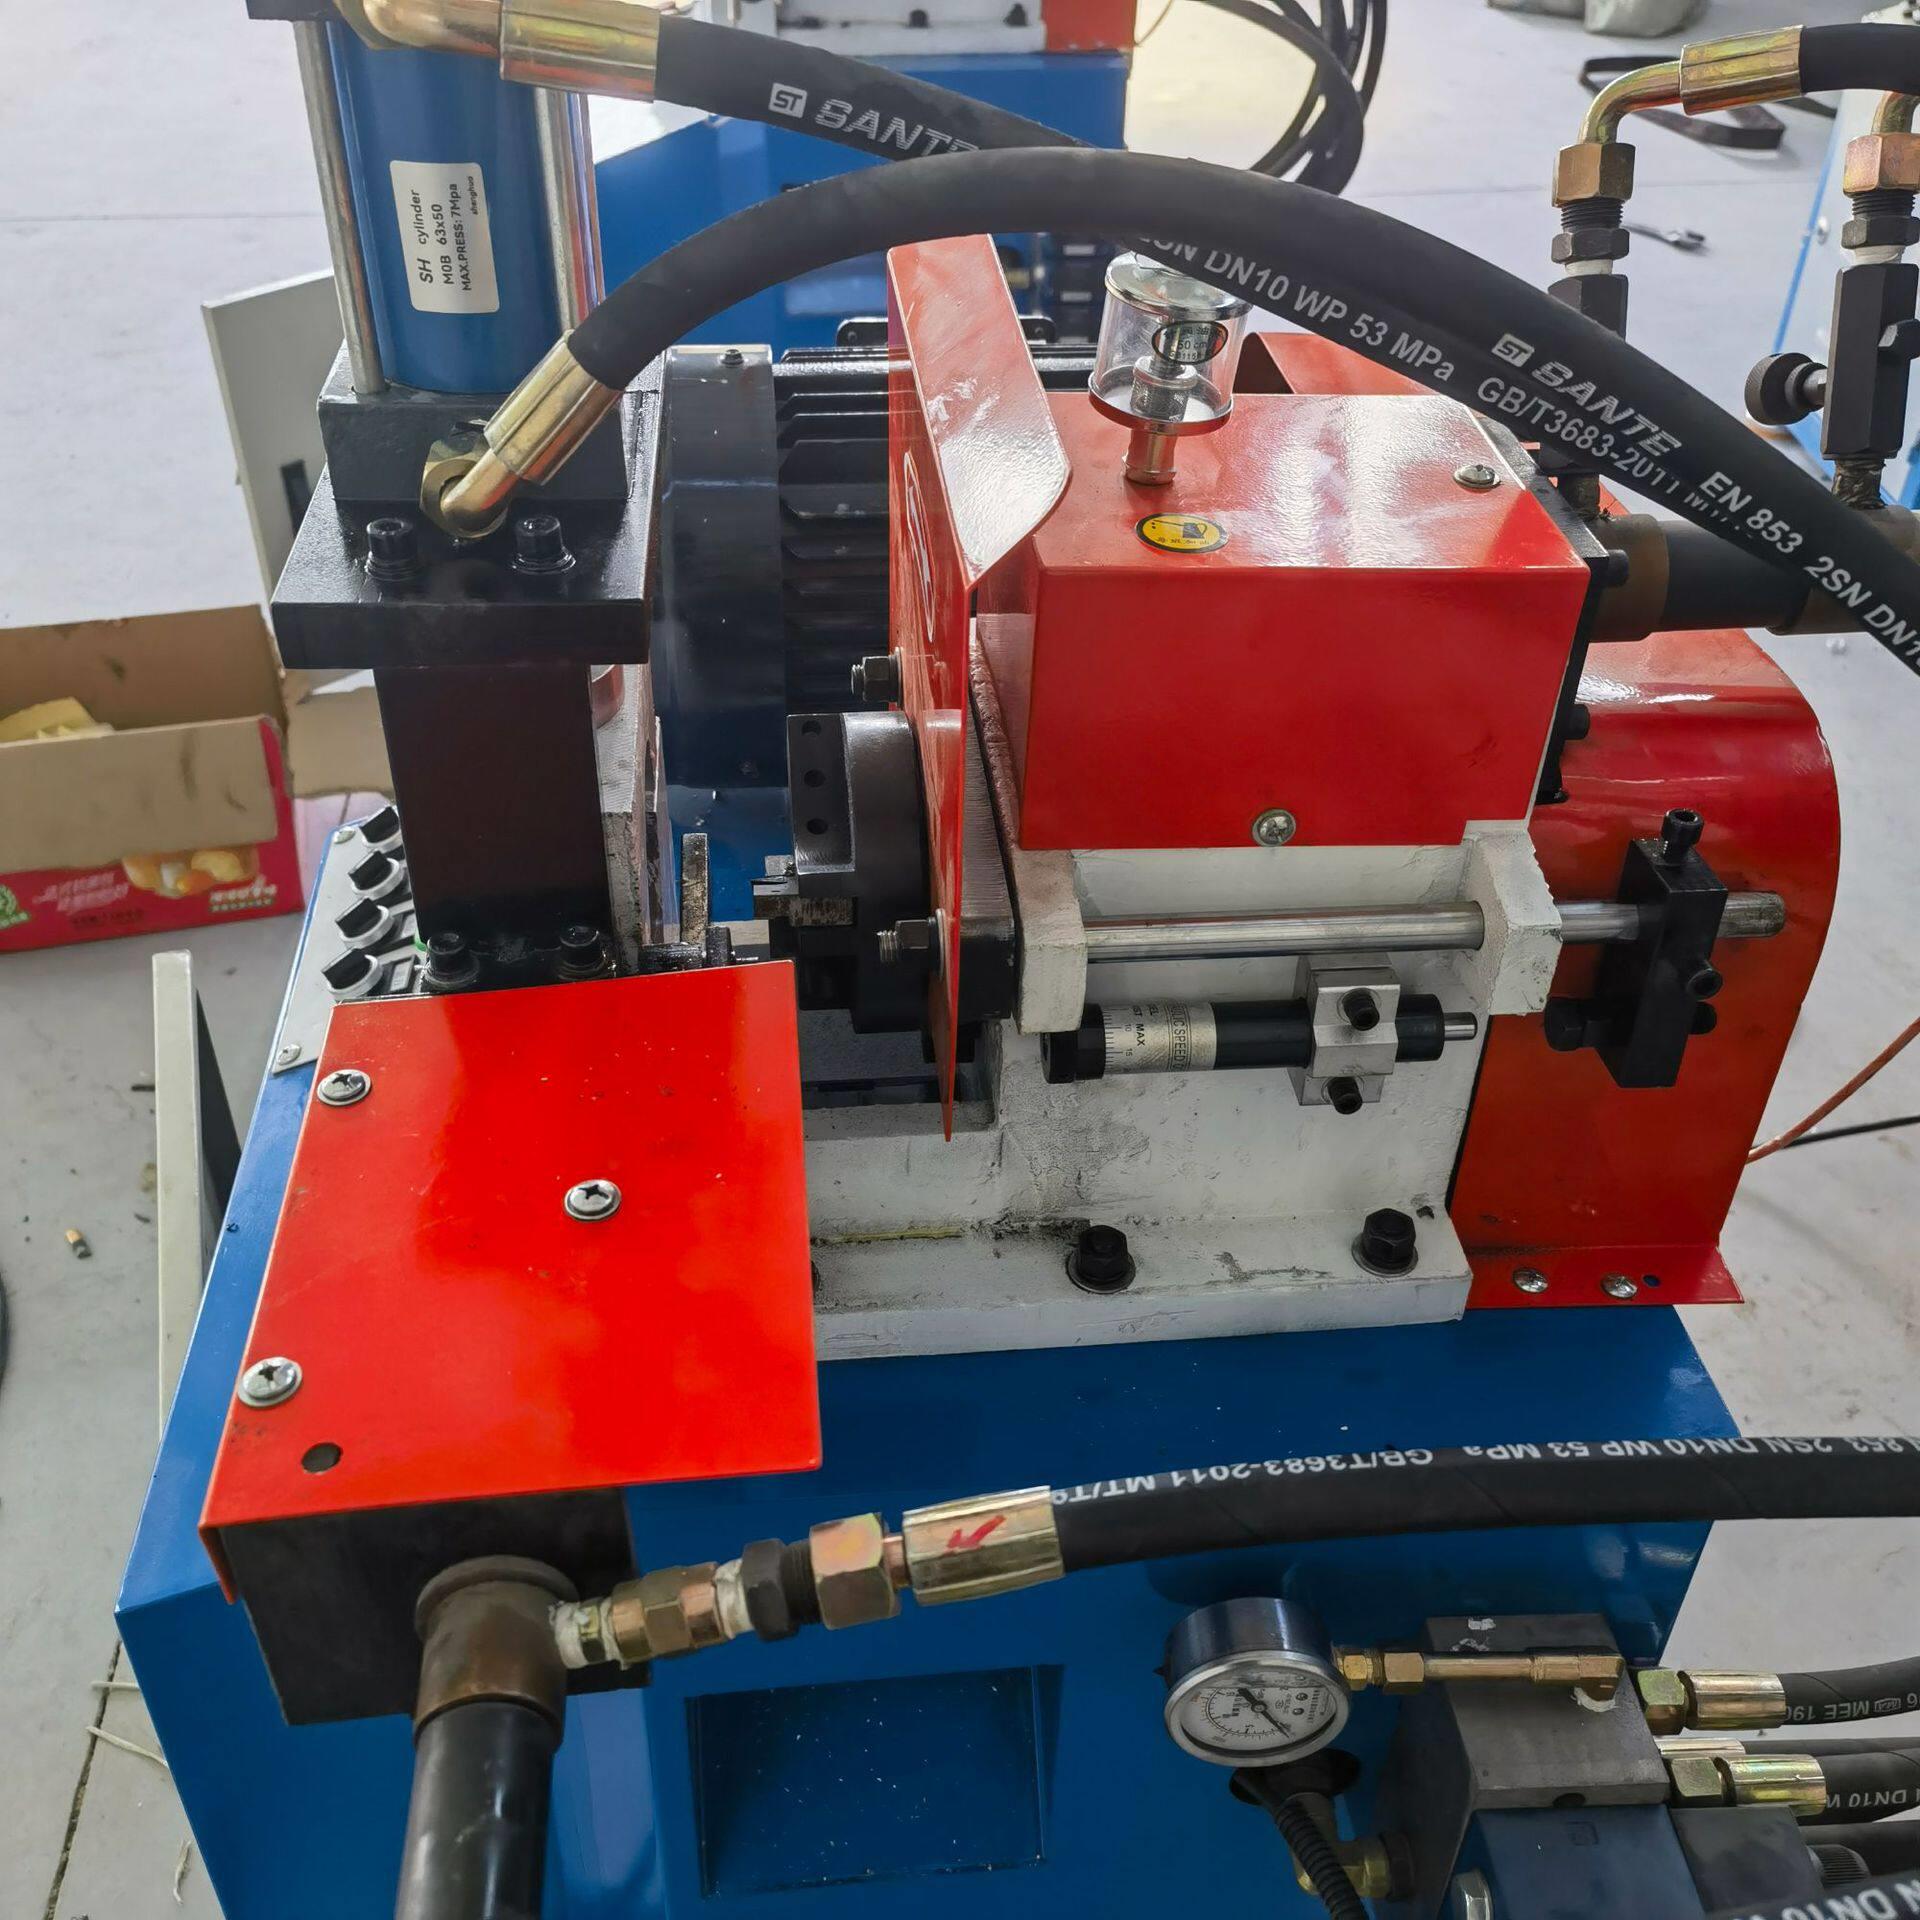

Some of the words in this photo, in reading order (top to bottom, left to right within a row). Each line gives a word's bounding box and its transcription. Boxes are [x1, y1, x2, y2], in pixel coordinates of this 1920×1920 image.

[410, 188, 430, 245] cylinder
[431, 203, 447, 245] 63x50
[417, 257, 433, 284] SH
[1204, 254, 1289, 300] DN10
[1293, 285, 1347, 323] WP
[1350, 312, 1389, 346] 53
[1390, 332, 1455, 381] MPa
[1532, 361, 1682, 456] SANTE
[1699, 471, 1752, 513] EN
[1746, 508, 1803, 553] 853
[1803, 556, 1872, 608] 2SN
[1863, 603, 1920, 668] DN1
[1135, 1023, 1146, 1047] MAX
[1173, 1028, 1187, 1062] SPEED
[1462, 1443, 1543, 1461] MPa
[1548, 1441, 1590, 1459] 53
[1602, 1440, 1661, 1459] WP
[1664, 1438, 1757, 1456] DN10
[1170, 1448, 1434, 1489] GB/T3683-2011
[1824, 1700, 1870, 1720] MEE
[1848, 1789, 1908, 1808] DN10
